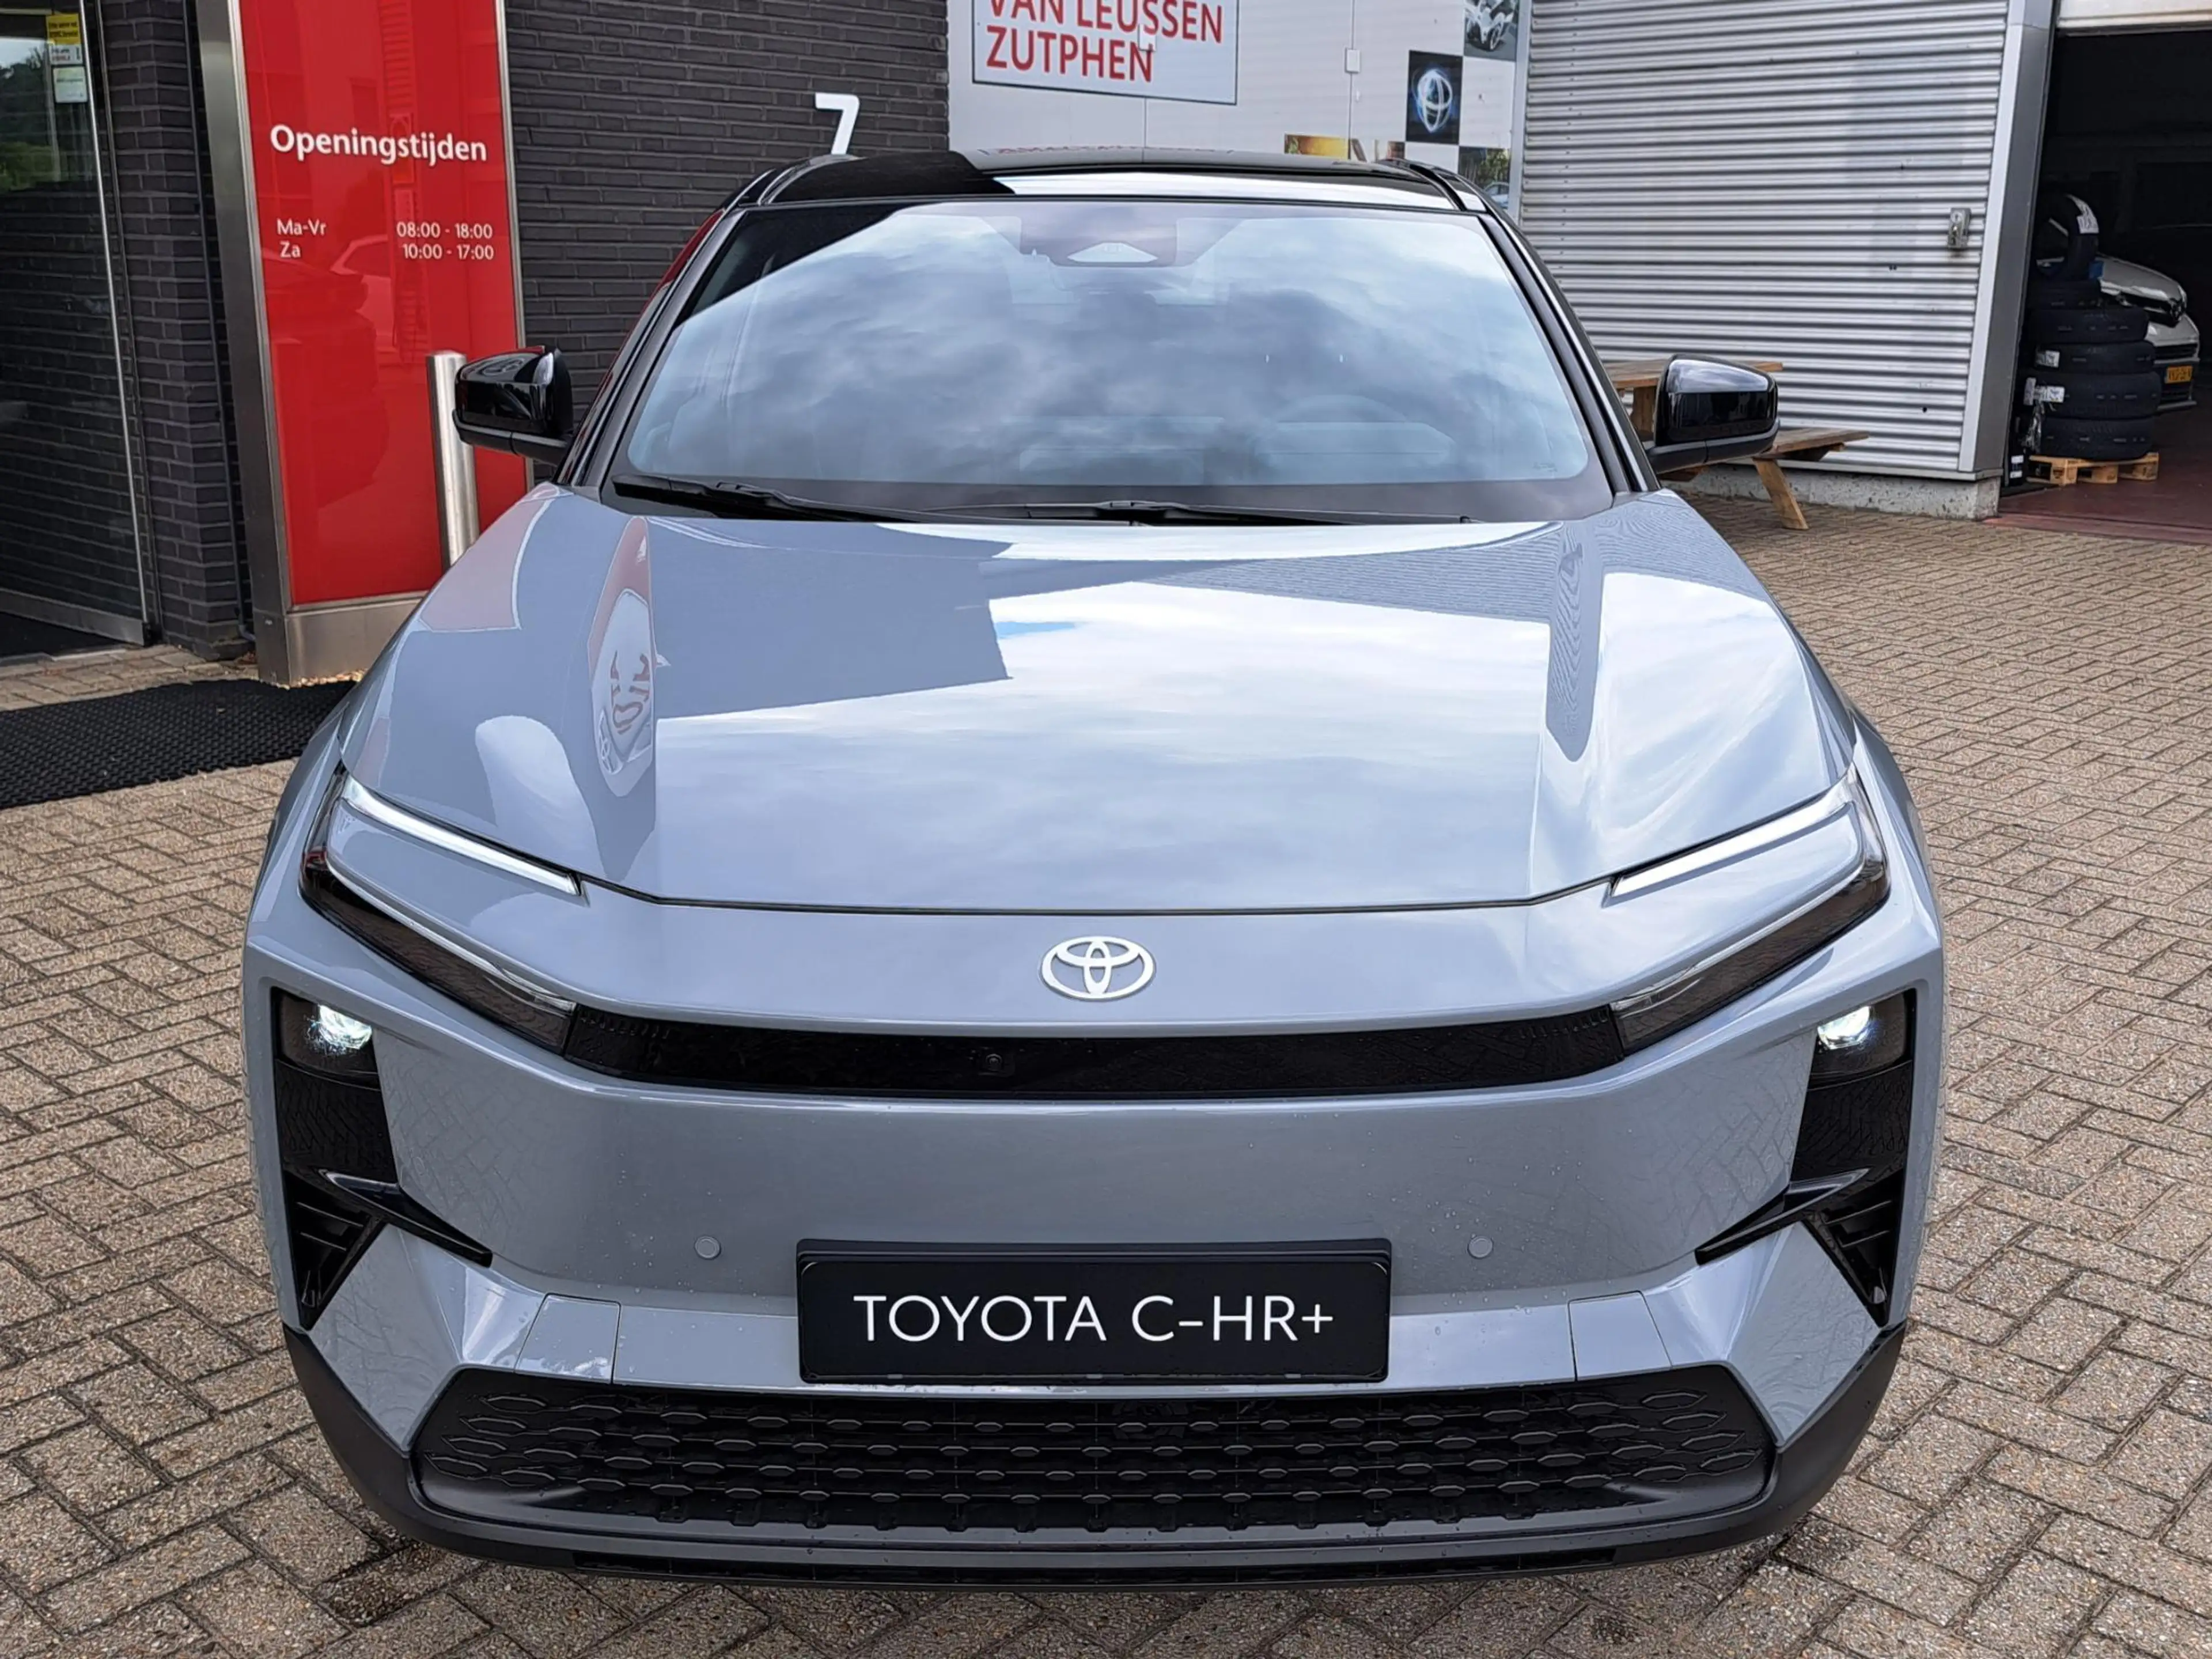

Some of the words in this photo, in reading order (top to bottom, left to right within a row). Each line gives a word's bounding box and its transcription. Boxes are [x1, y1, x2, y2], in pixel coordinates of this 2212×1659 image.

[1077, 0, 1222, 43] LEUSSEN
[987, 25, 1154, 82] ZUTPHEN
[815, 92, 860, 154] 7
[270, 124, 487, 166] Openingstijden
[277, 219, 326, 235] Ma-Vr
[396, 221, 441, 238] 08:00
[454, 222, 493, 239] 18:00
[280, 241, 301, 258] Za
[402, 243, 442, 259] 10:00
[456, 244, 494, 260] 17:00
[853, 1295, 1107, 1342] TOYOTA
[1131, 1295, 1334, 1342] C-HR+
